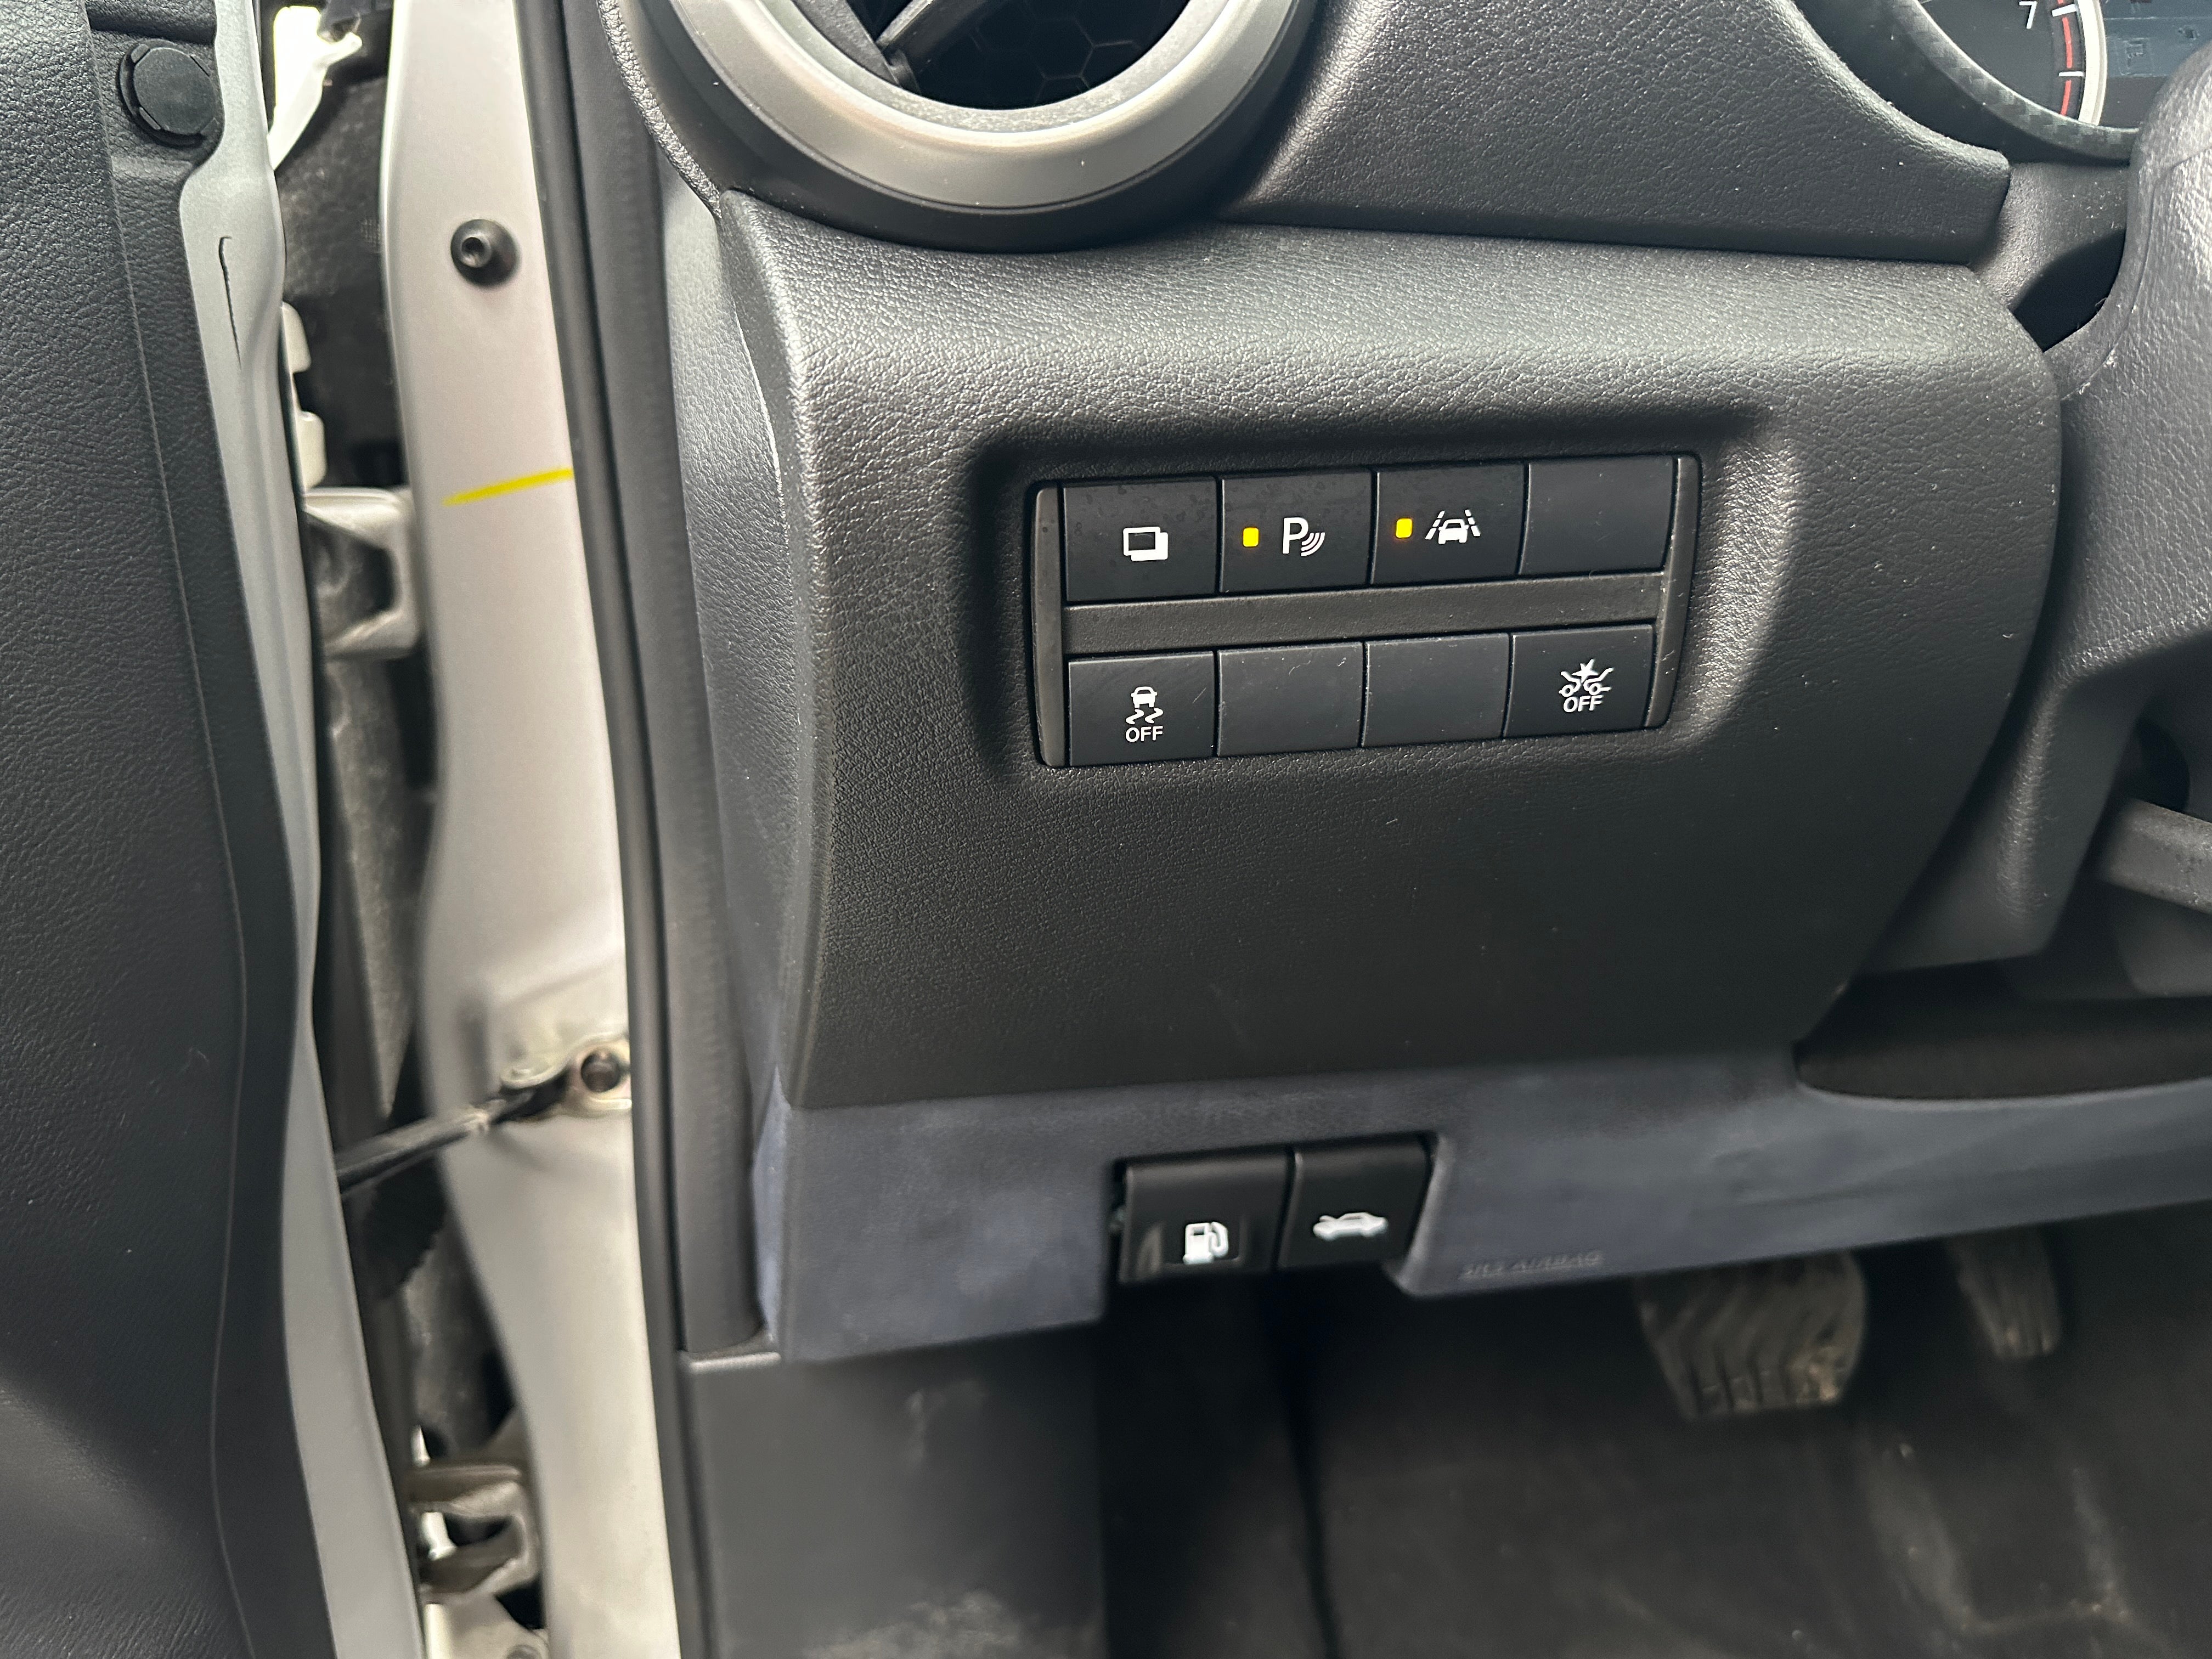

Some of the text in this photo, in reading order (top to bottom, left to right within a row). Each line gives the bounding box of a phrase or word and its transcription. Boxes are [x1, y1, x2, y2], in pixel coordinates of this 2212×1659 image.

[2019, 1, 2038, 30] 7
[1283, 517, 1309, 554] P
[1563, 695, 1603, 713] OFF
[1125, 726, 1164, 742] OFF
